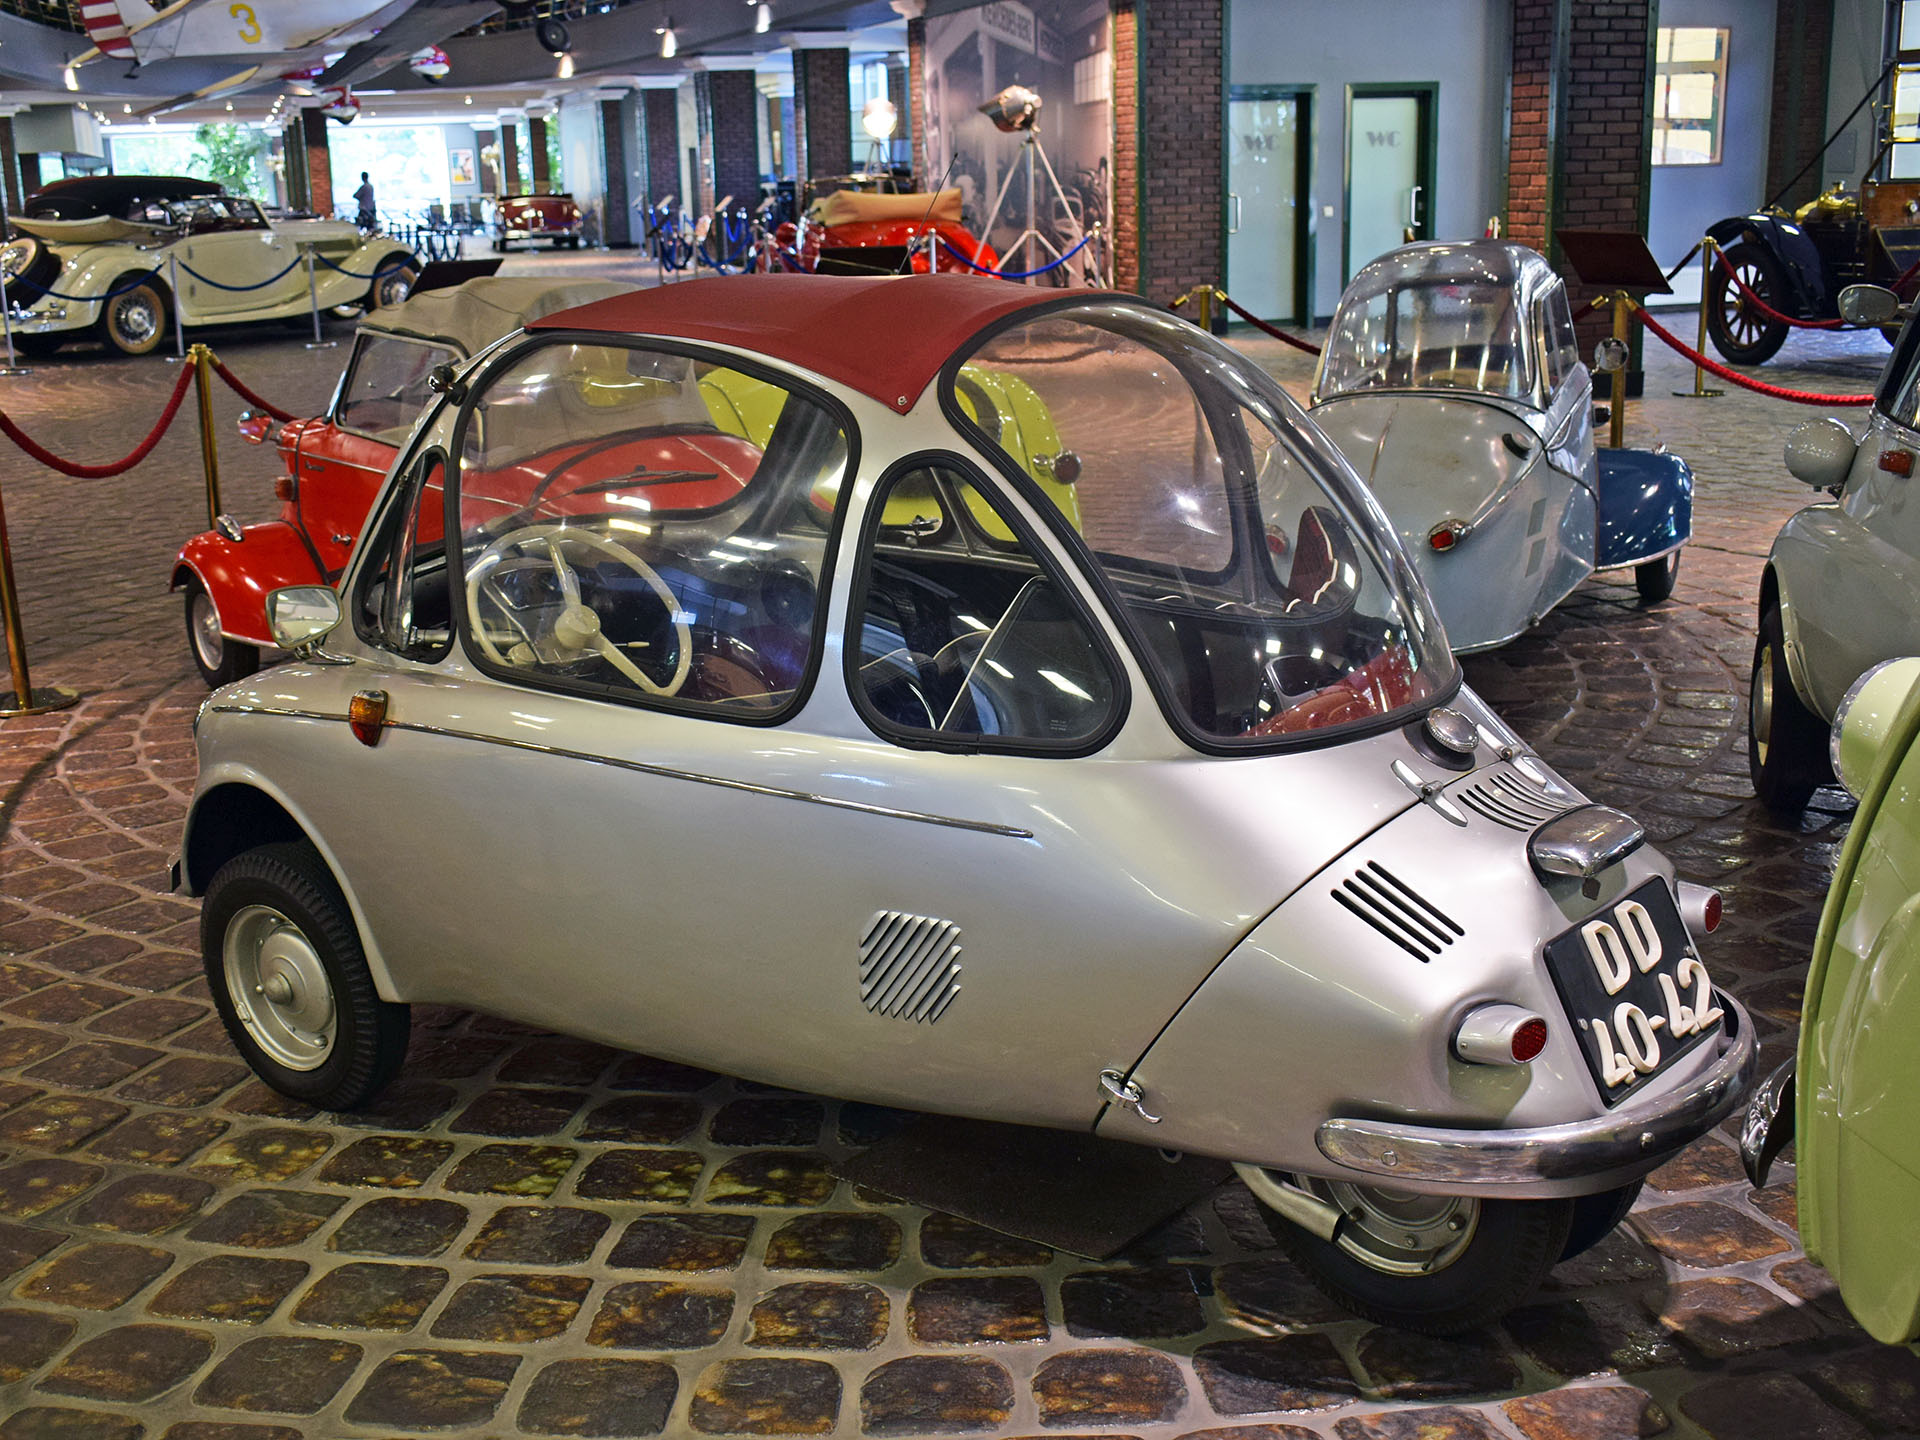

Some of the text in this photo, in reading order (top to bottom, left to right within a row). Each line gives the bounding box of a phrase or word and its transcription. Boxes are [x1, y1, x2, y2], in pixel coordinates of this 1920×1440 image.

[229, 3, 262, 44] 3
[1366, 131, 1401, 147] WC
[1581, 900, 1662, 996] DD
[1591, 958, 1725, 1088] 40-42
